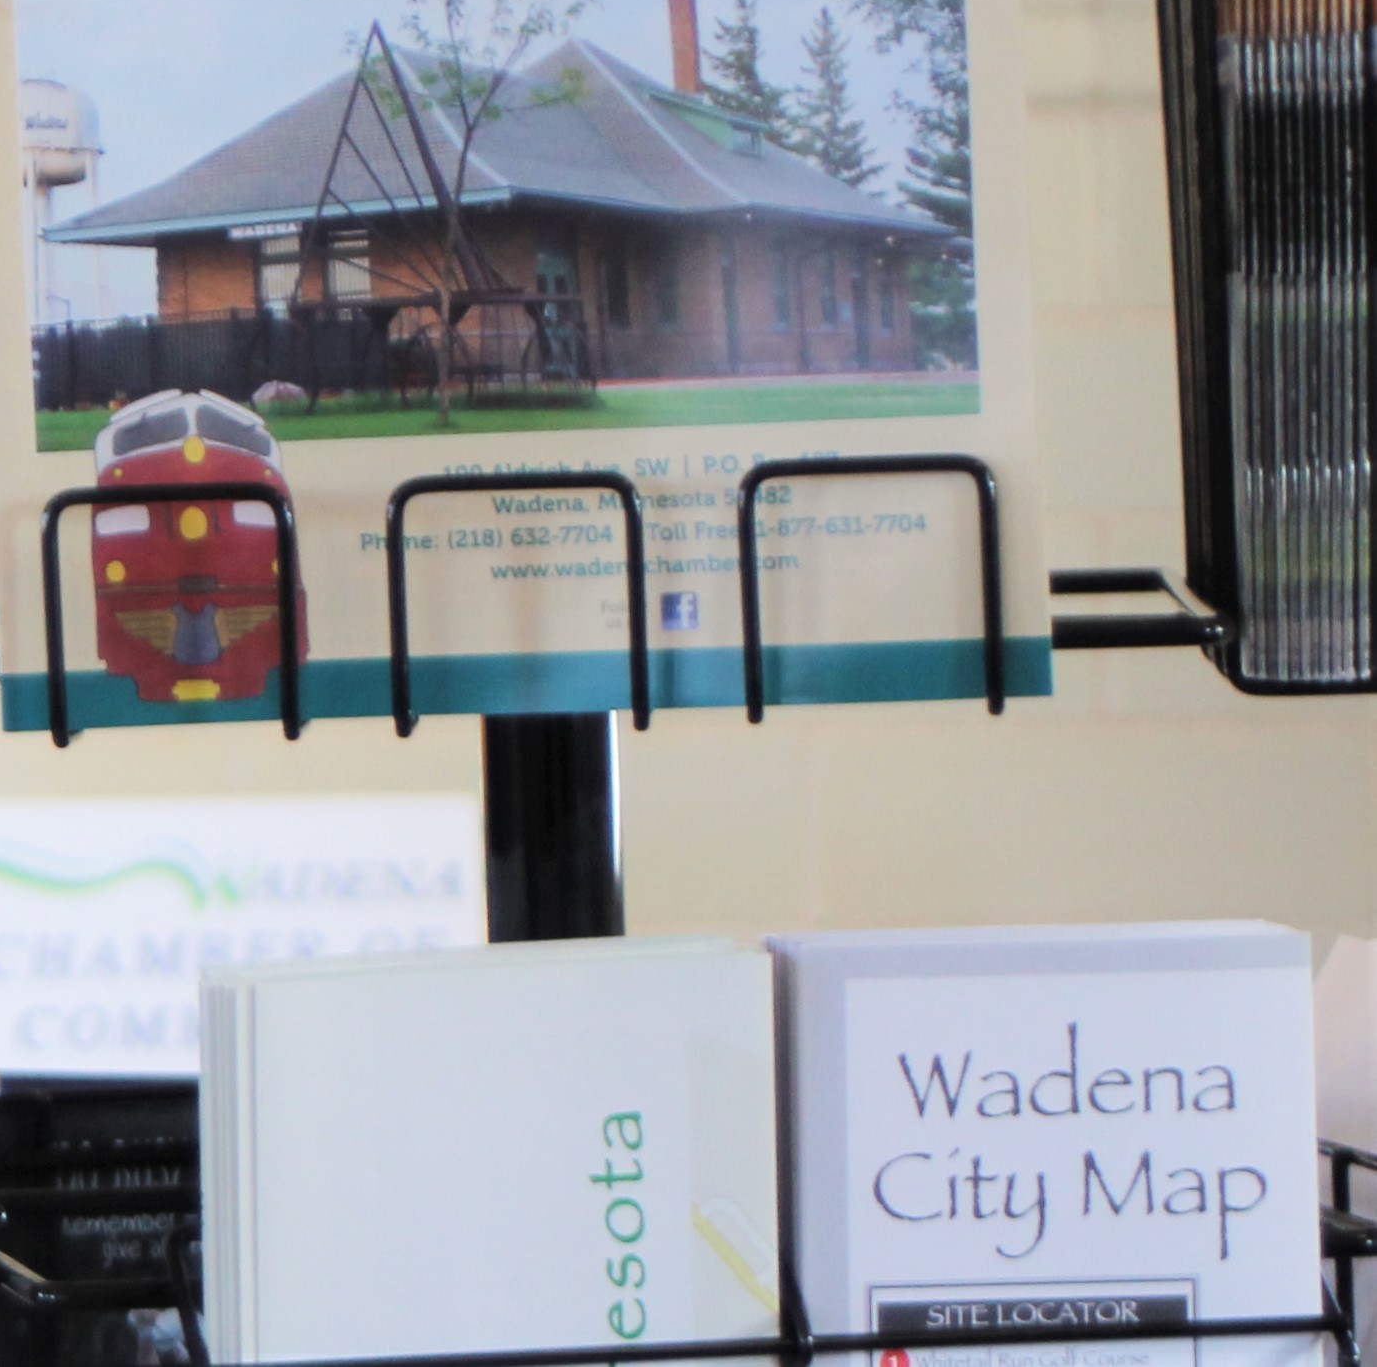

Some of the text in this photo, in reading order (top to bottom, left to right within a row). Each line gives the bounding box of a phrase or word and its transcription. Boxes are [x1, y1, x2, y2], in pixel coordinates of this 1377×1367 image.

[634, 457, 671, 477] SW
[492, 493, 590, 514] Wadena,
[598, 488, 717, 511] Mnesota
[360, 531, 439, 551] Phne:
[448, 527, 503, 550] (218)
[511, 522, 615, 546] 632-7704
[649, 520, 688, 541] Toll
[897, 1021, 1238, 1120] Wadena
[872, 1147, 1269, 1260] City Map
[587, 1110, 646, 1340] esota
[925, 1299, 1141, 1327] SITE LOCATOR
